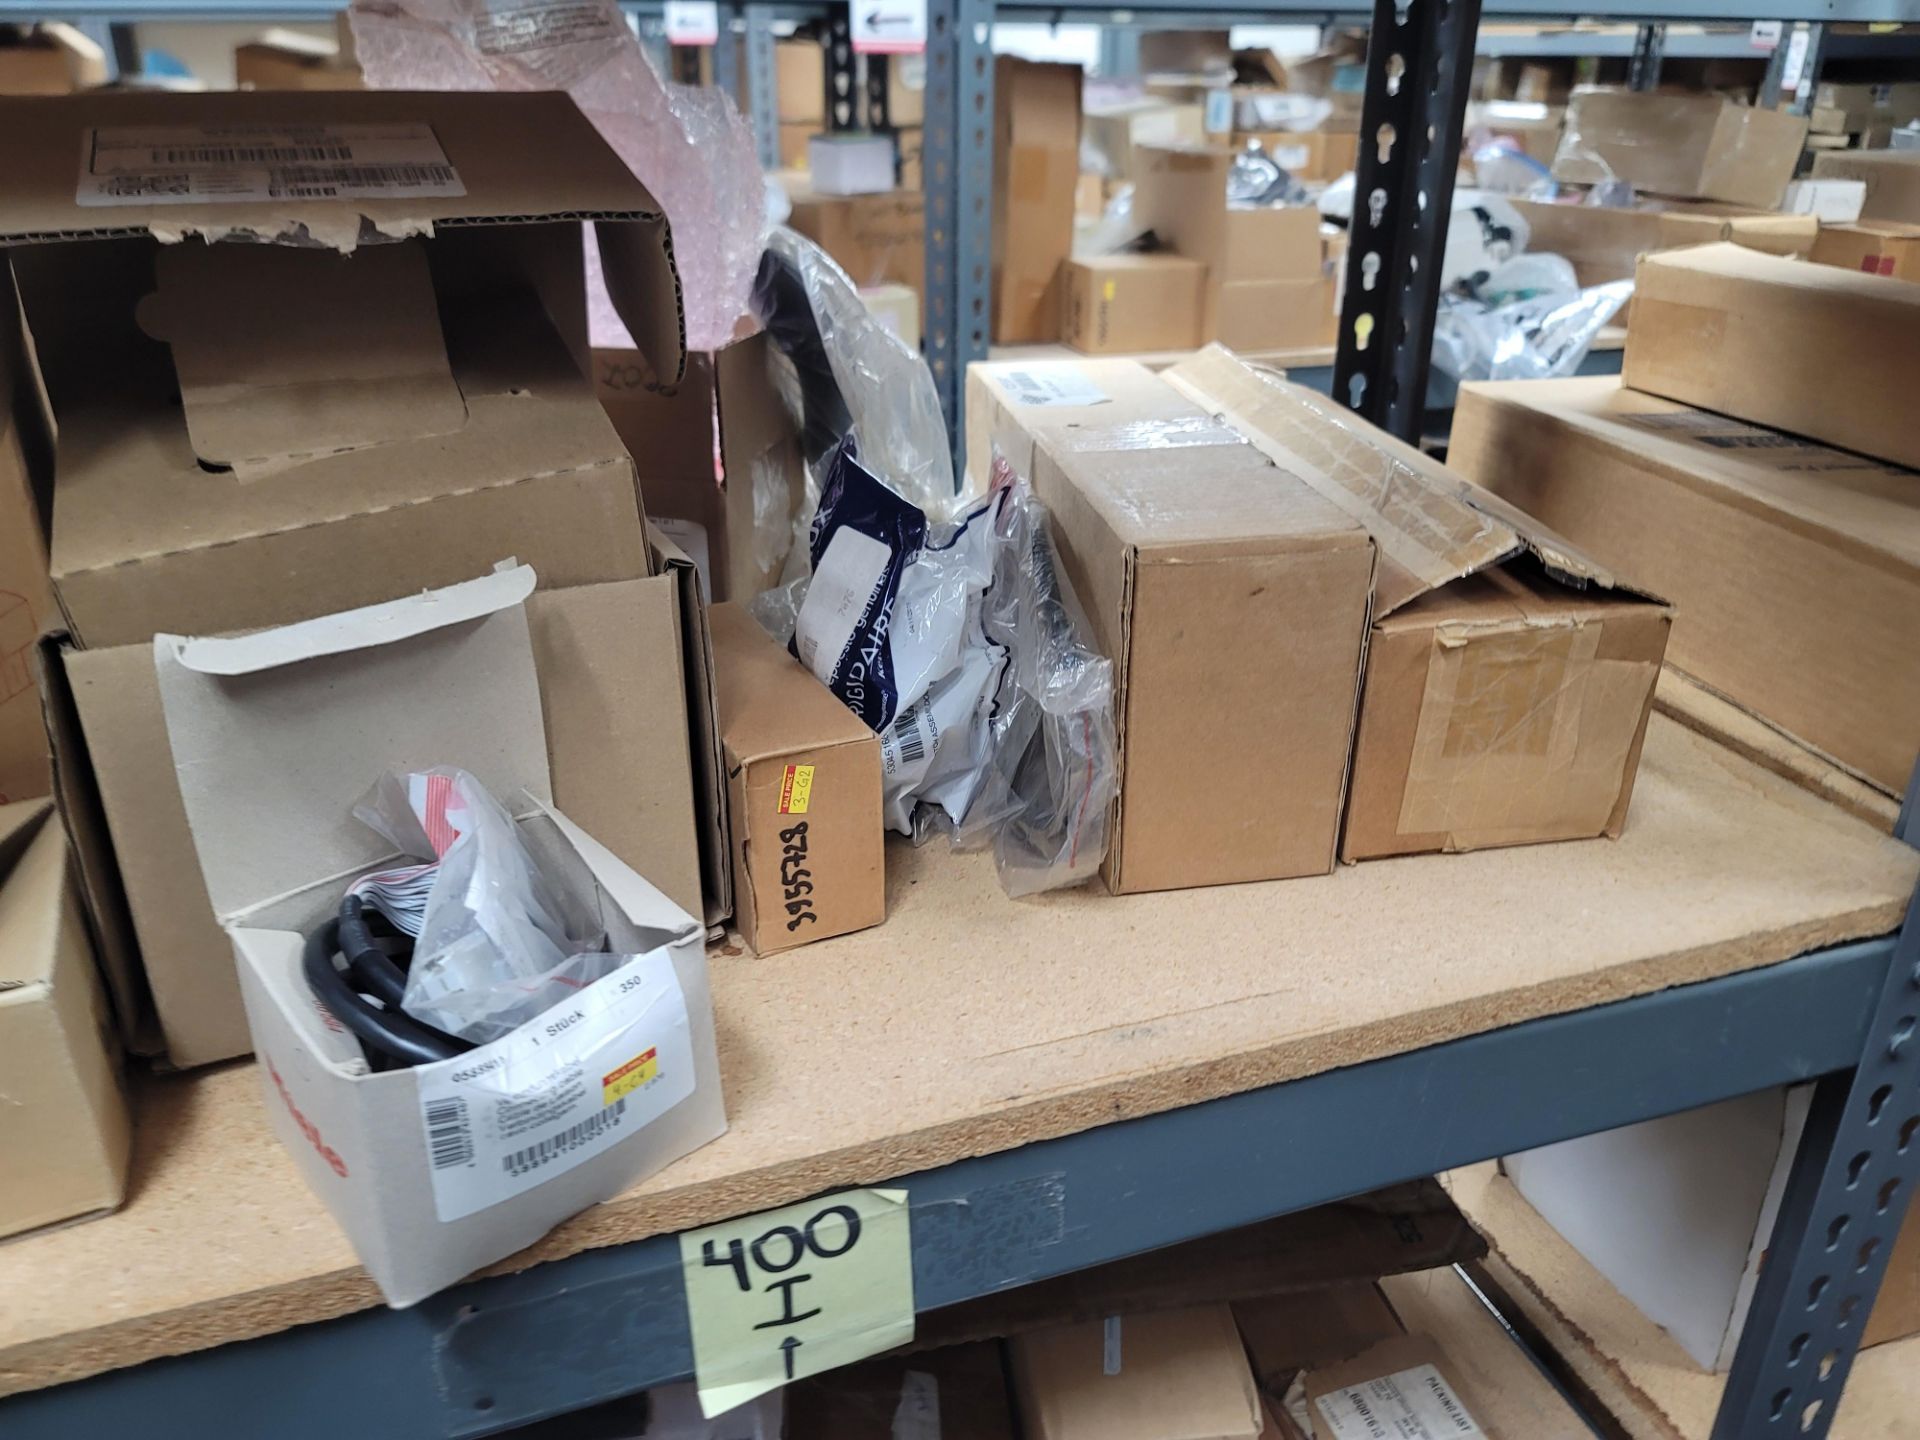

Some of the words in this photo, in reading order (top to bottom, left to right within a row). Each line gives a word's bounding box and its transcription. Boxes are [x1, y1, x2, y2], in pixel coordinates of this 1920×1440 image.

[785, 773, 794, 792] PRICE
[779, 821, 817, 931] 3955728
[532, 1036, 540, 1046] 1
[545, 1009, 586, 1038] Stück
[619, 975, 642, 994] 350
[702, 1205, 861, 1291] 400
[752, 1273, 822, 1330] I
[1425, 1376, 1457, 1418] PACKING
[1450, 1412, 1473, 1433] LIST
